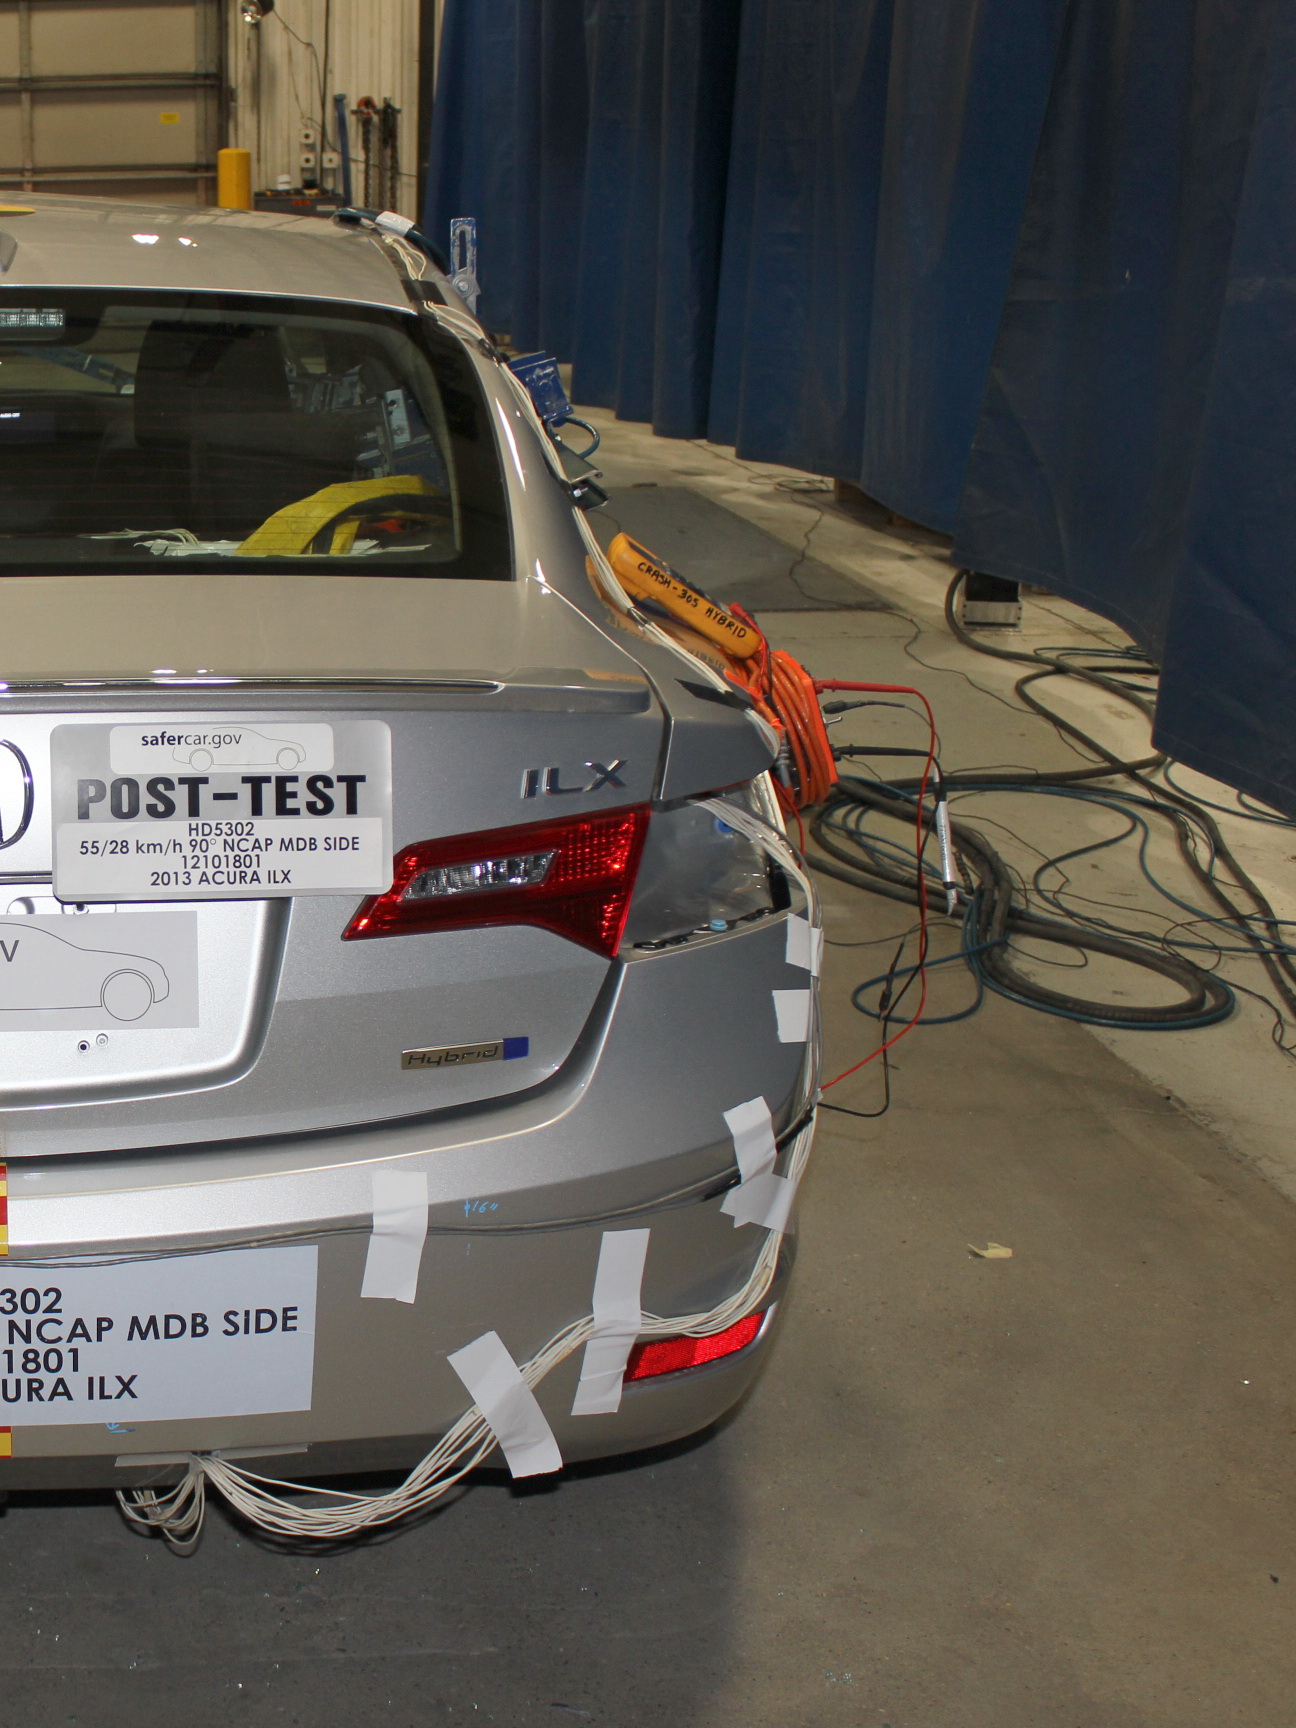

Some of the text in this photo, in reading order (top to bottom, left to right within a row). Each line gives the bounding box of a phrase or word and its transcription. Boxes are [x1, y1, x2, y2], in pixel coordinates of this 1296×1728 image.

[705, 606, 748, 639] HYBRID
[141, 731, 242, 749] safercar.gov
[520, 759, 628, 799] ILX
[77, 774, 367, 820] POST-TEST
[188, 822, 255, 837] HD5302
[79, 836, 360, 857] 55/28 km/h 90° NCAP MDB SIDE
[181, 854, 261, 869] 12101801
[150, 869, 292, 886] 2013 ACURA ILX
[407, 1045, 499, 1066] Hybrid
[7, 1316, 114, 1345] NCAP
[127, 1312, 209, 1341] MDB
[222, 1306, 298, 1337] SIDE
[87, 1374, 139, 1401] ILX
